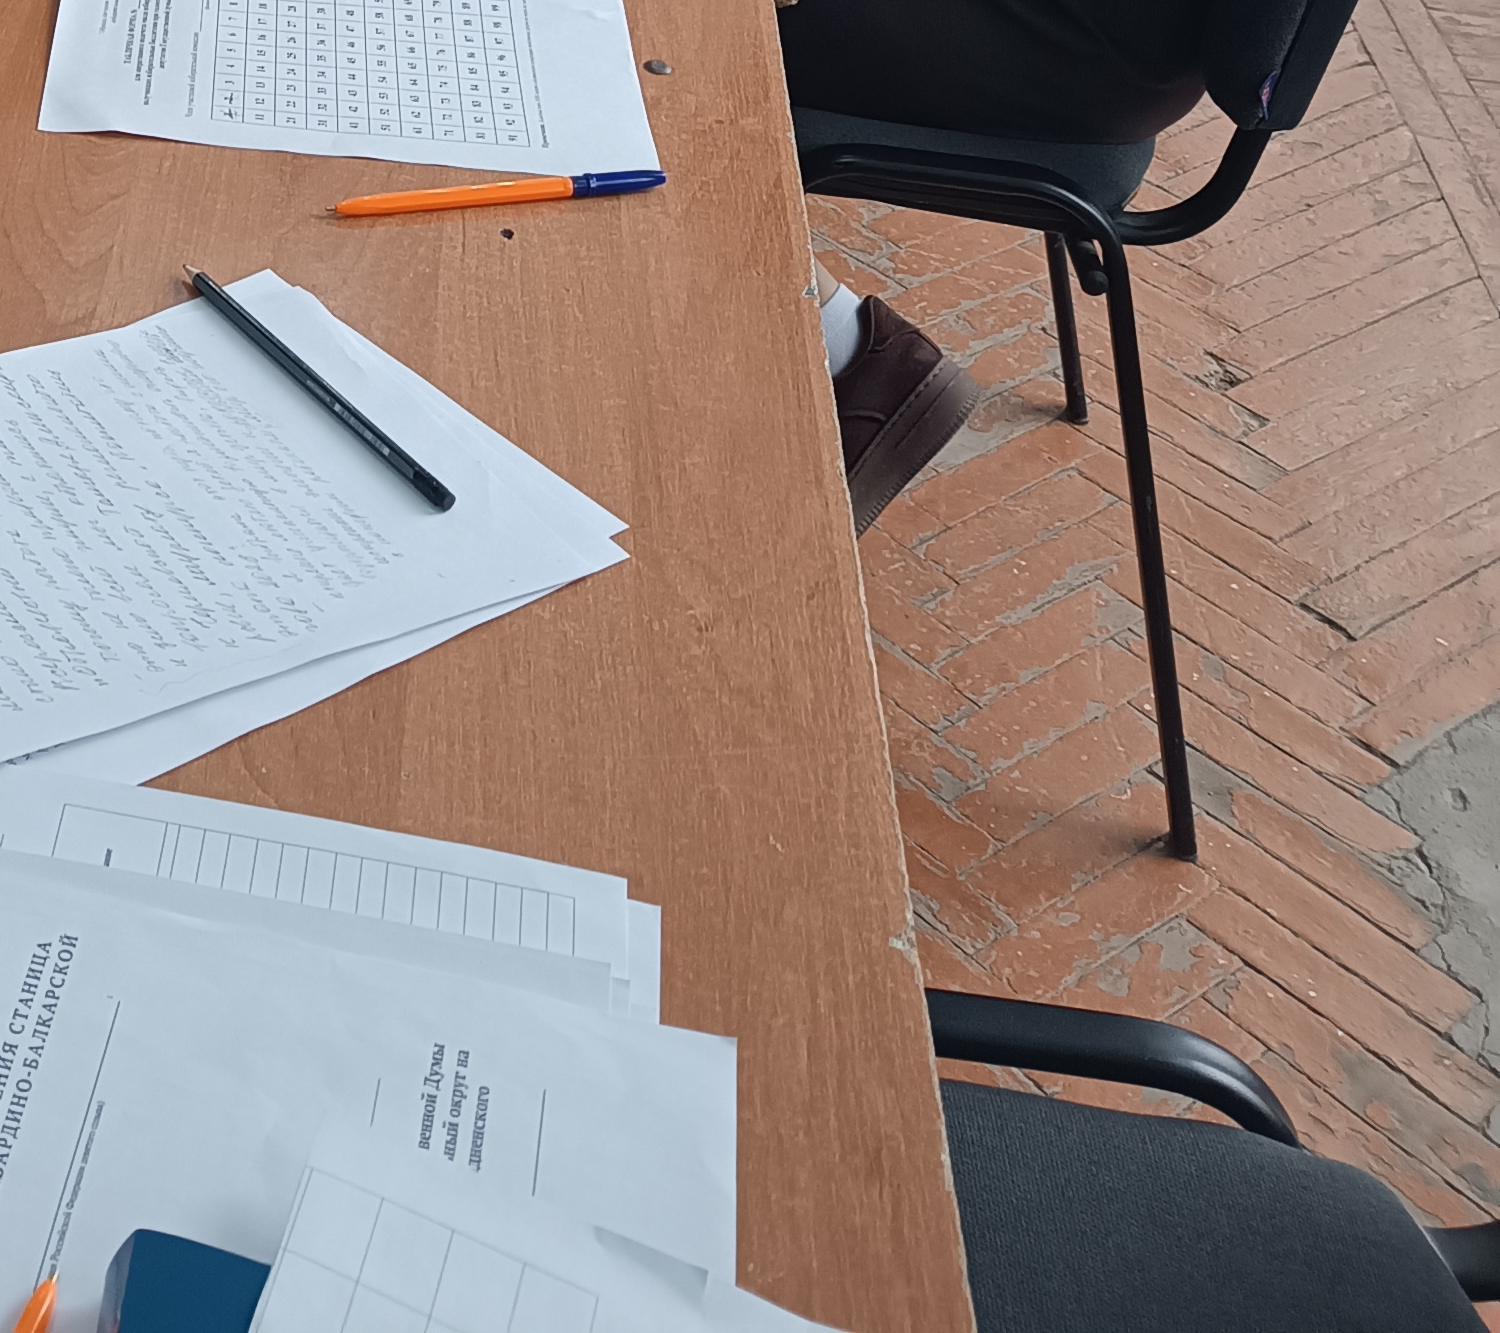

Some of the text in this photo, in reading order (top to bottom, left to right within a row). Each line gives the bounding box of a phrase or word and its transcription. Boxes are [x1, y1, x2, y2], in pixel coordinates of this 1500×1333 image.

[8, 942, 52, 1035] СТАНИЦА
[418, 1042, 445, 1150] венной Думы
[442, 1049, 470, 1162] ный округ на
